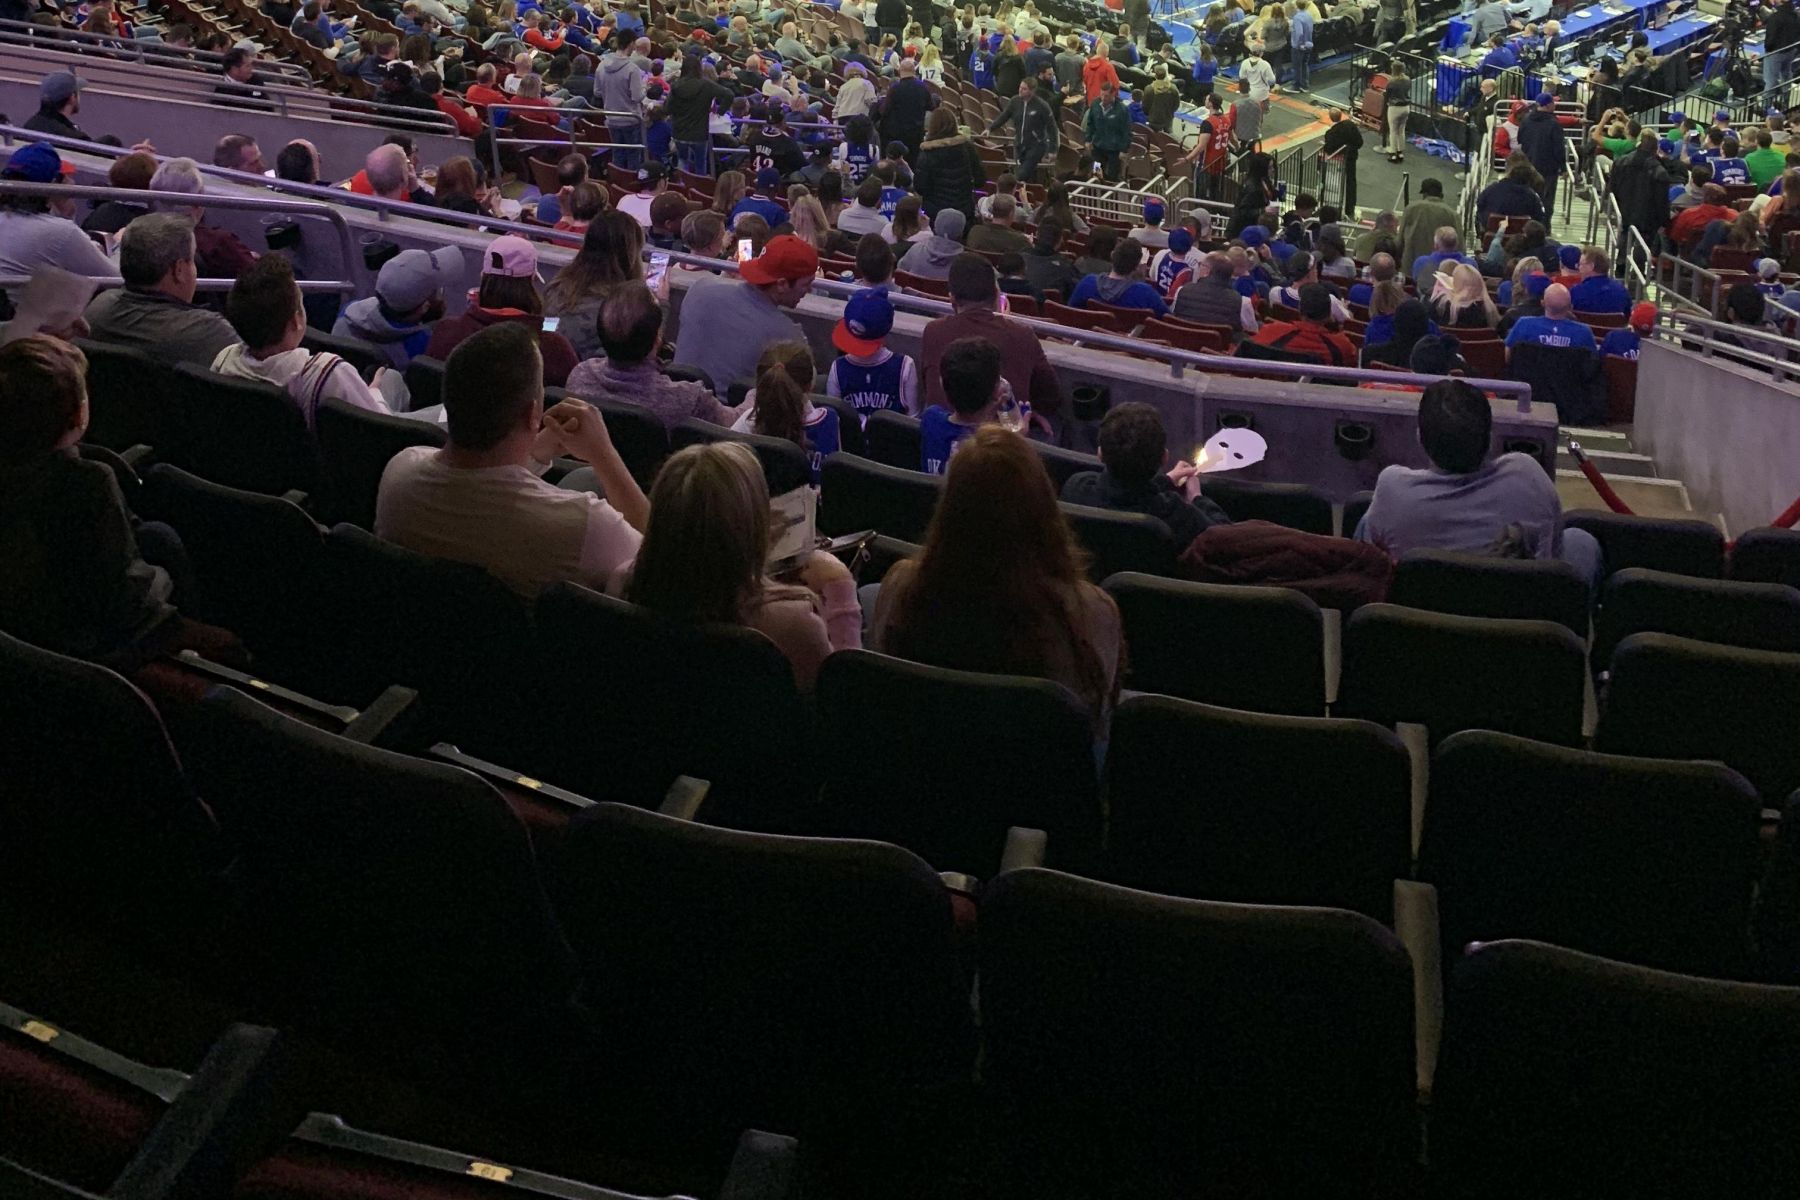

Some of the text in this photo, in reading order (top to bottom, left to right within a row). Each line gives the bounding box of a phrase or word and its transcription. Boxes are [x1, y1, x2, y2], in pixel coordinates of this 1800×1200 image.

[974, 60, 985, 72] 21
[925, 69, 936, 79] 17
[1214, 132, 1229, 150] 23
[848, 163, 870, 180] 25
